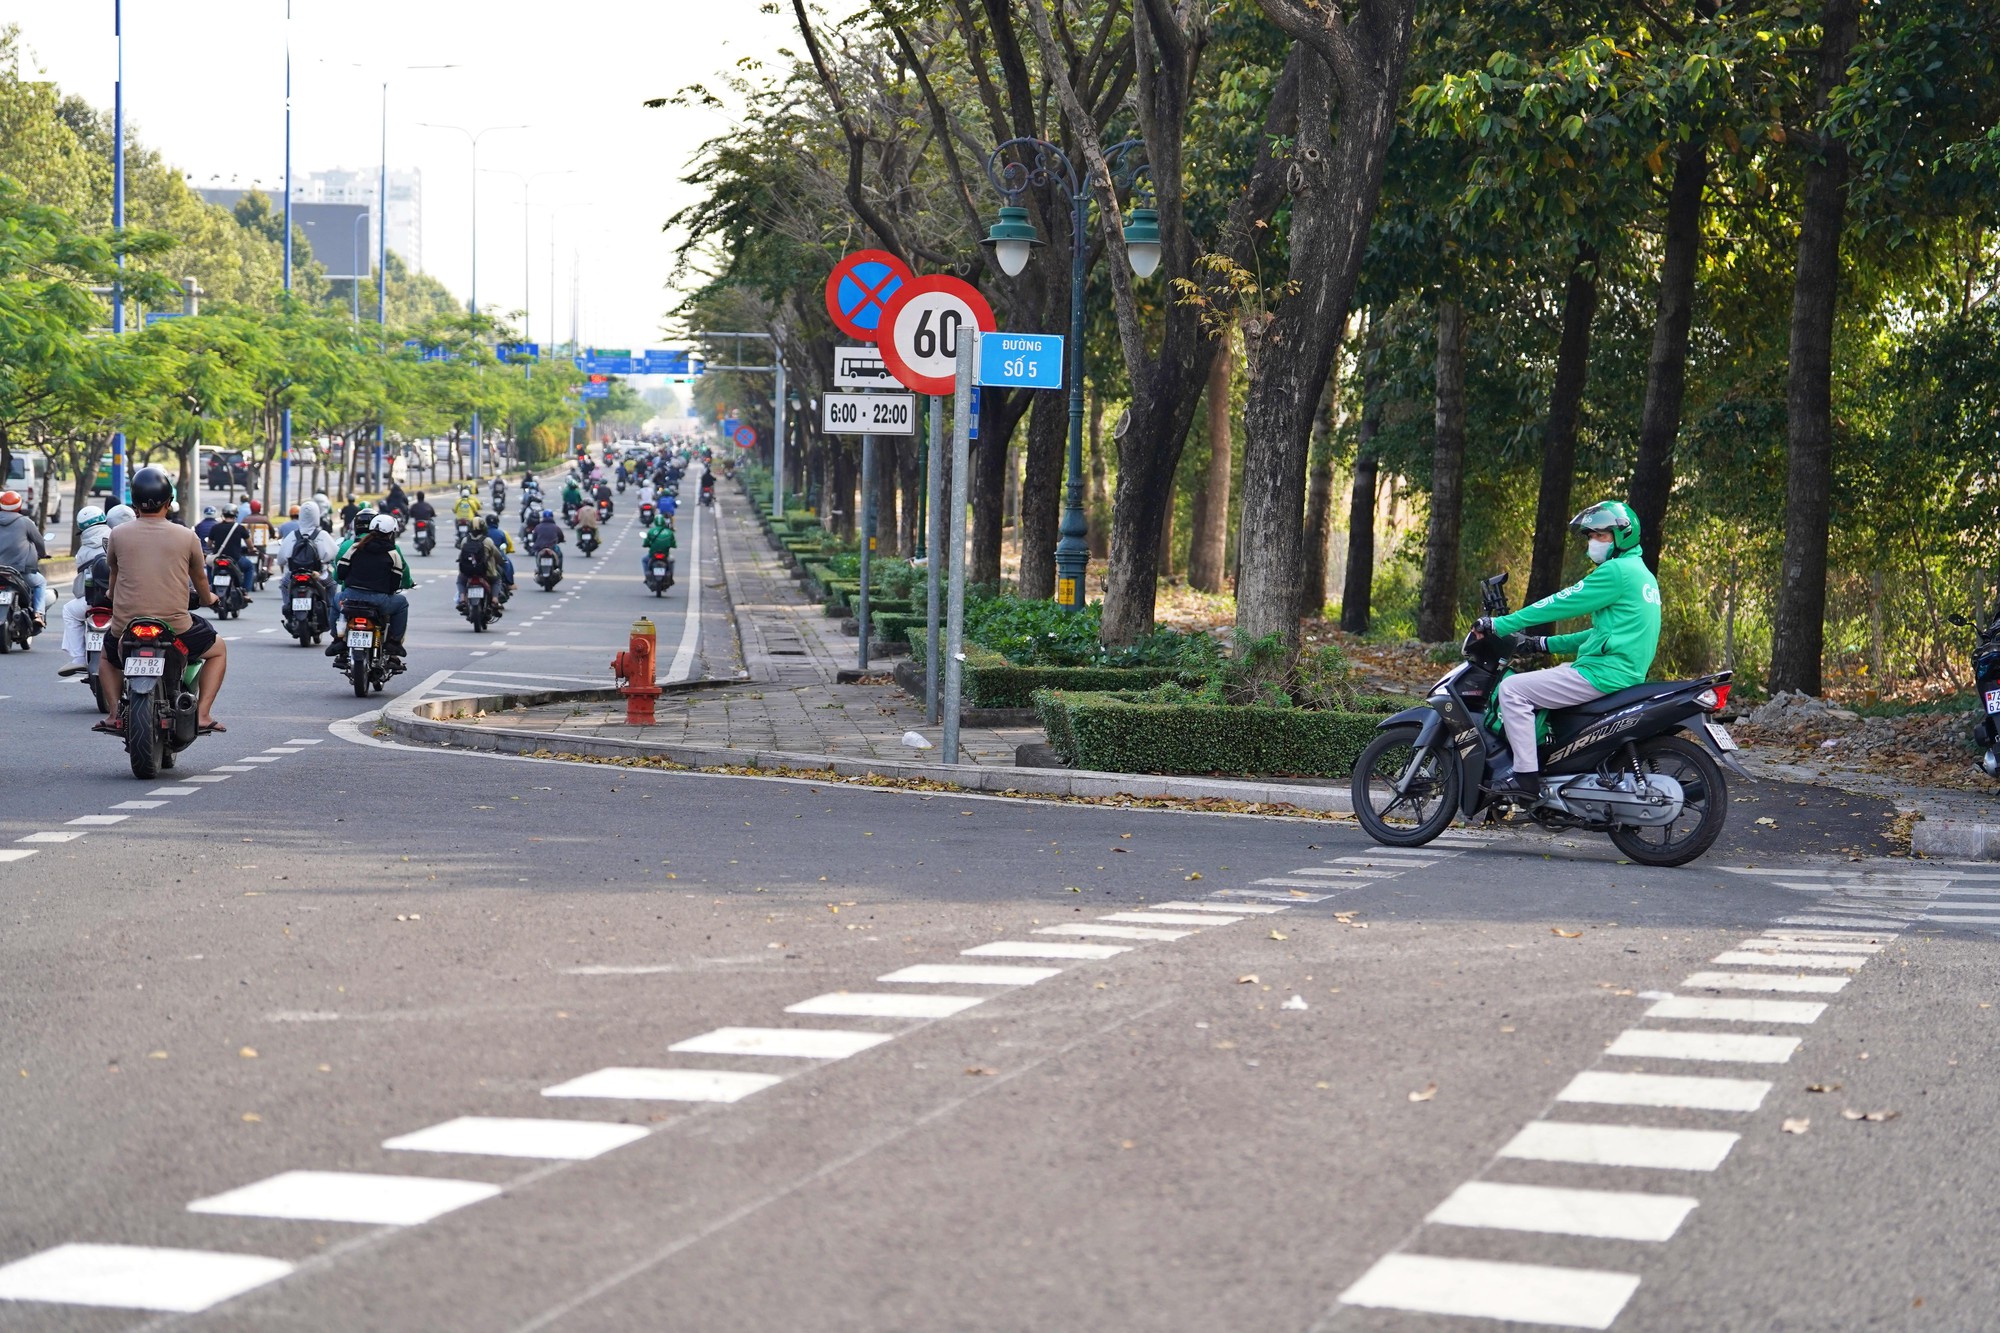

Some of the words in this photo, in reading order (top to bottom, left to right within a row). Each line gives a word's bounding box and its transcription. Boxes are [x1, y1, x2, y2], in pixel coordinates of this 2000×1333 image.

[914, 309, 962, 358] 60
[1002, 338, 1042, 352] ĐƯỜNG
[1003, 354, 1026, 377] SỐ
[1028, 361, 1038, 378] 5
[830, 403, 857, 423] 6:00
[873, 403, 908, 424] 22:00
[127, 666, 161, 674] 798.84
[1545, 715, 1643, 766] SIRIUS
